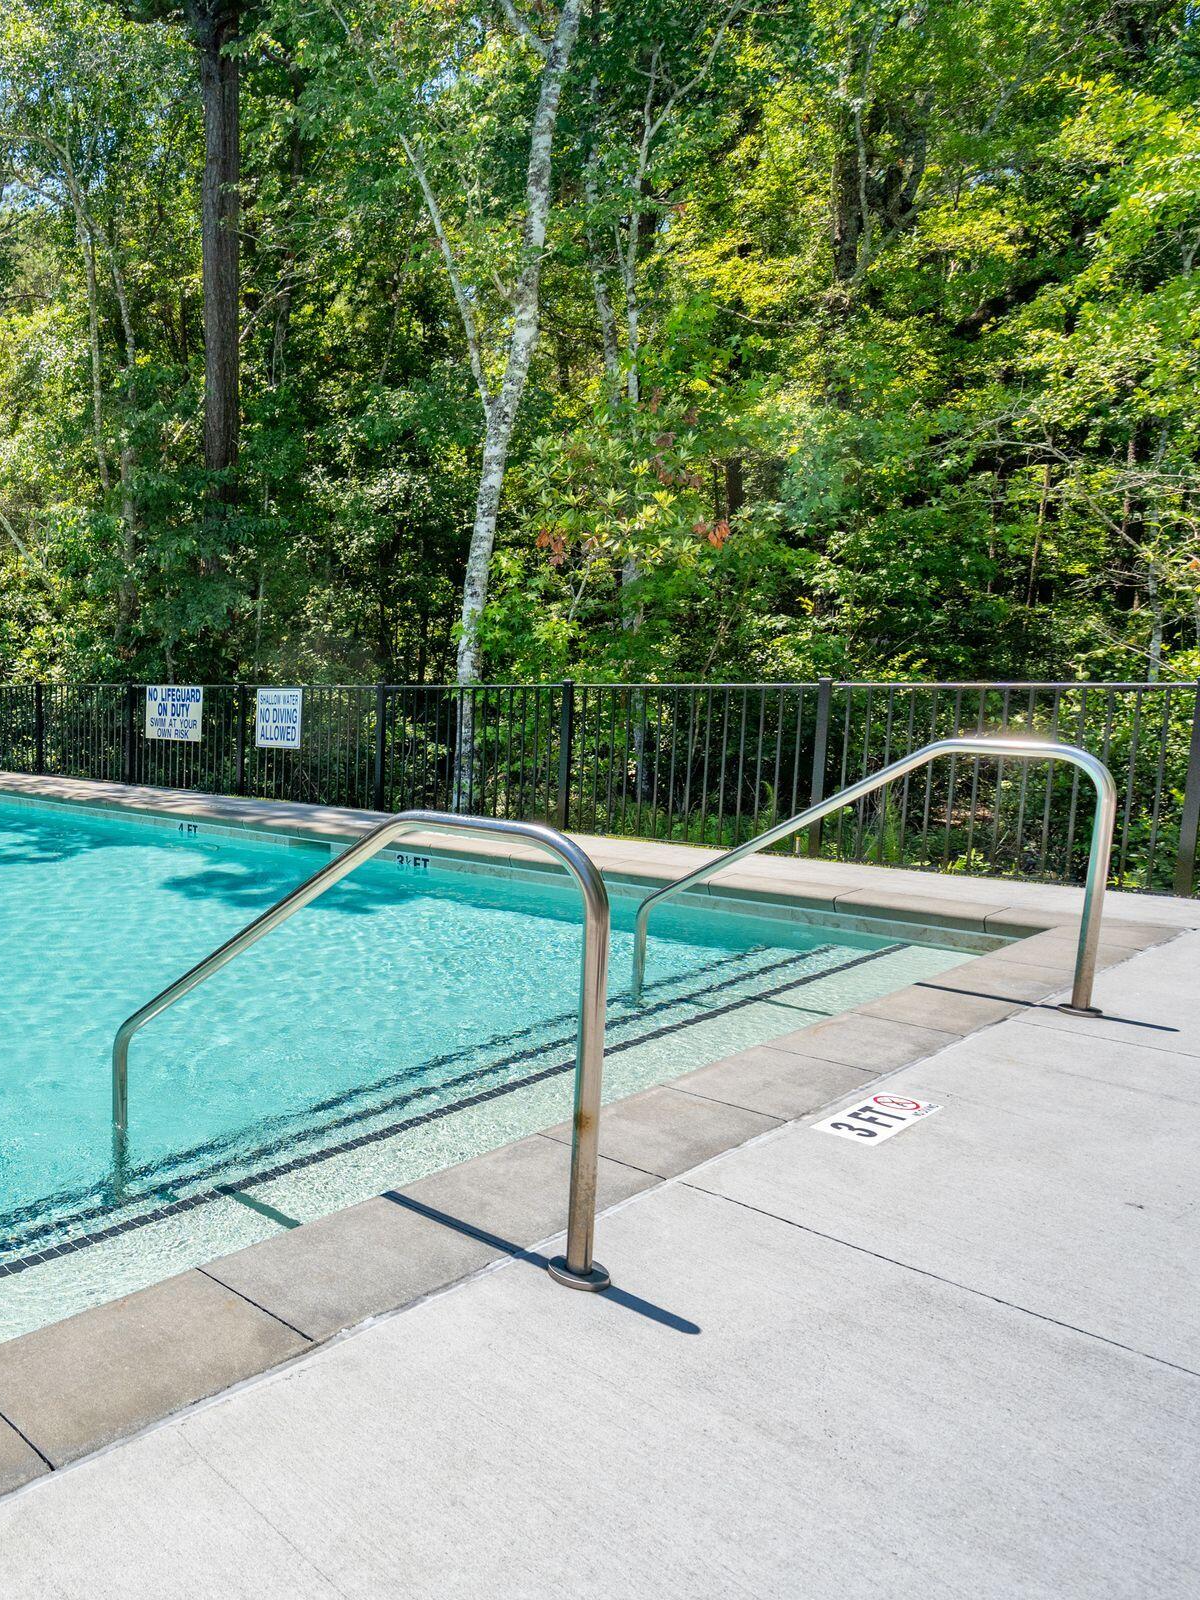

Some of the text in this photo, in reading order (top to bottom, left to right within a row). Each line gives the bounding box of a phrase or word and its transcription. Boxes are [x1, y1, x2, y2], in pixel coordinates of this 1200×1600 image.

[148, 688, 201, 703] NO LIFEGUARD
[260, 694, 298, 705] SHALLOW WATER
[157, 702, 190, 717] ON DUTY
[260, 707, 298, 724] NO DIVING
[150, 717, 197, 730] SWIM AT YOUR
[156, 728, 190, 740] OWN RISK
[260, 725, 297, 742] ALLOWED
[187, 823, 199, 833] FT
[413, 856, 430, 868] FT
[829, 1105, 907, 1138] 3 FT
